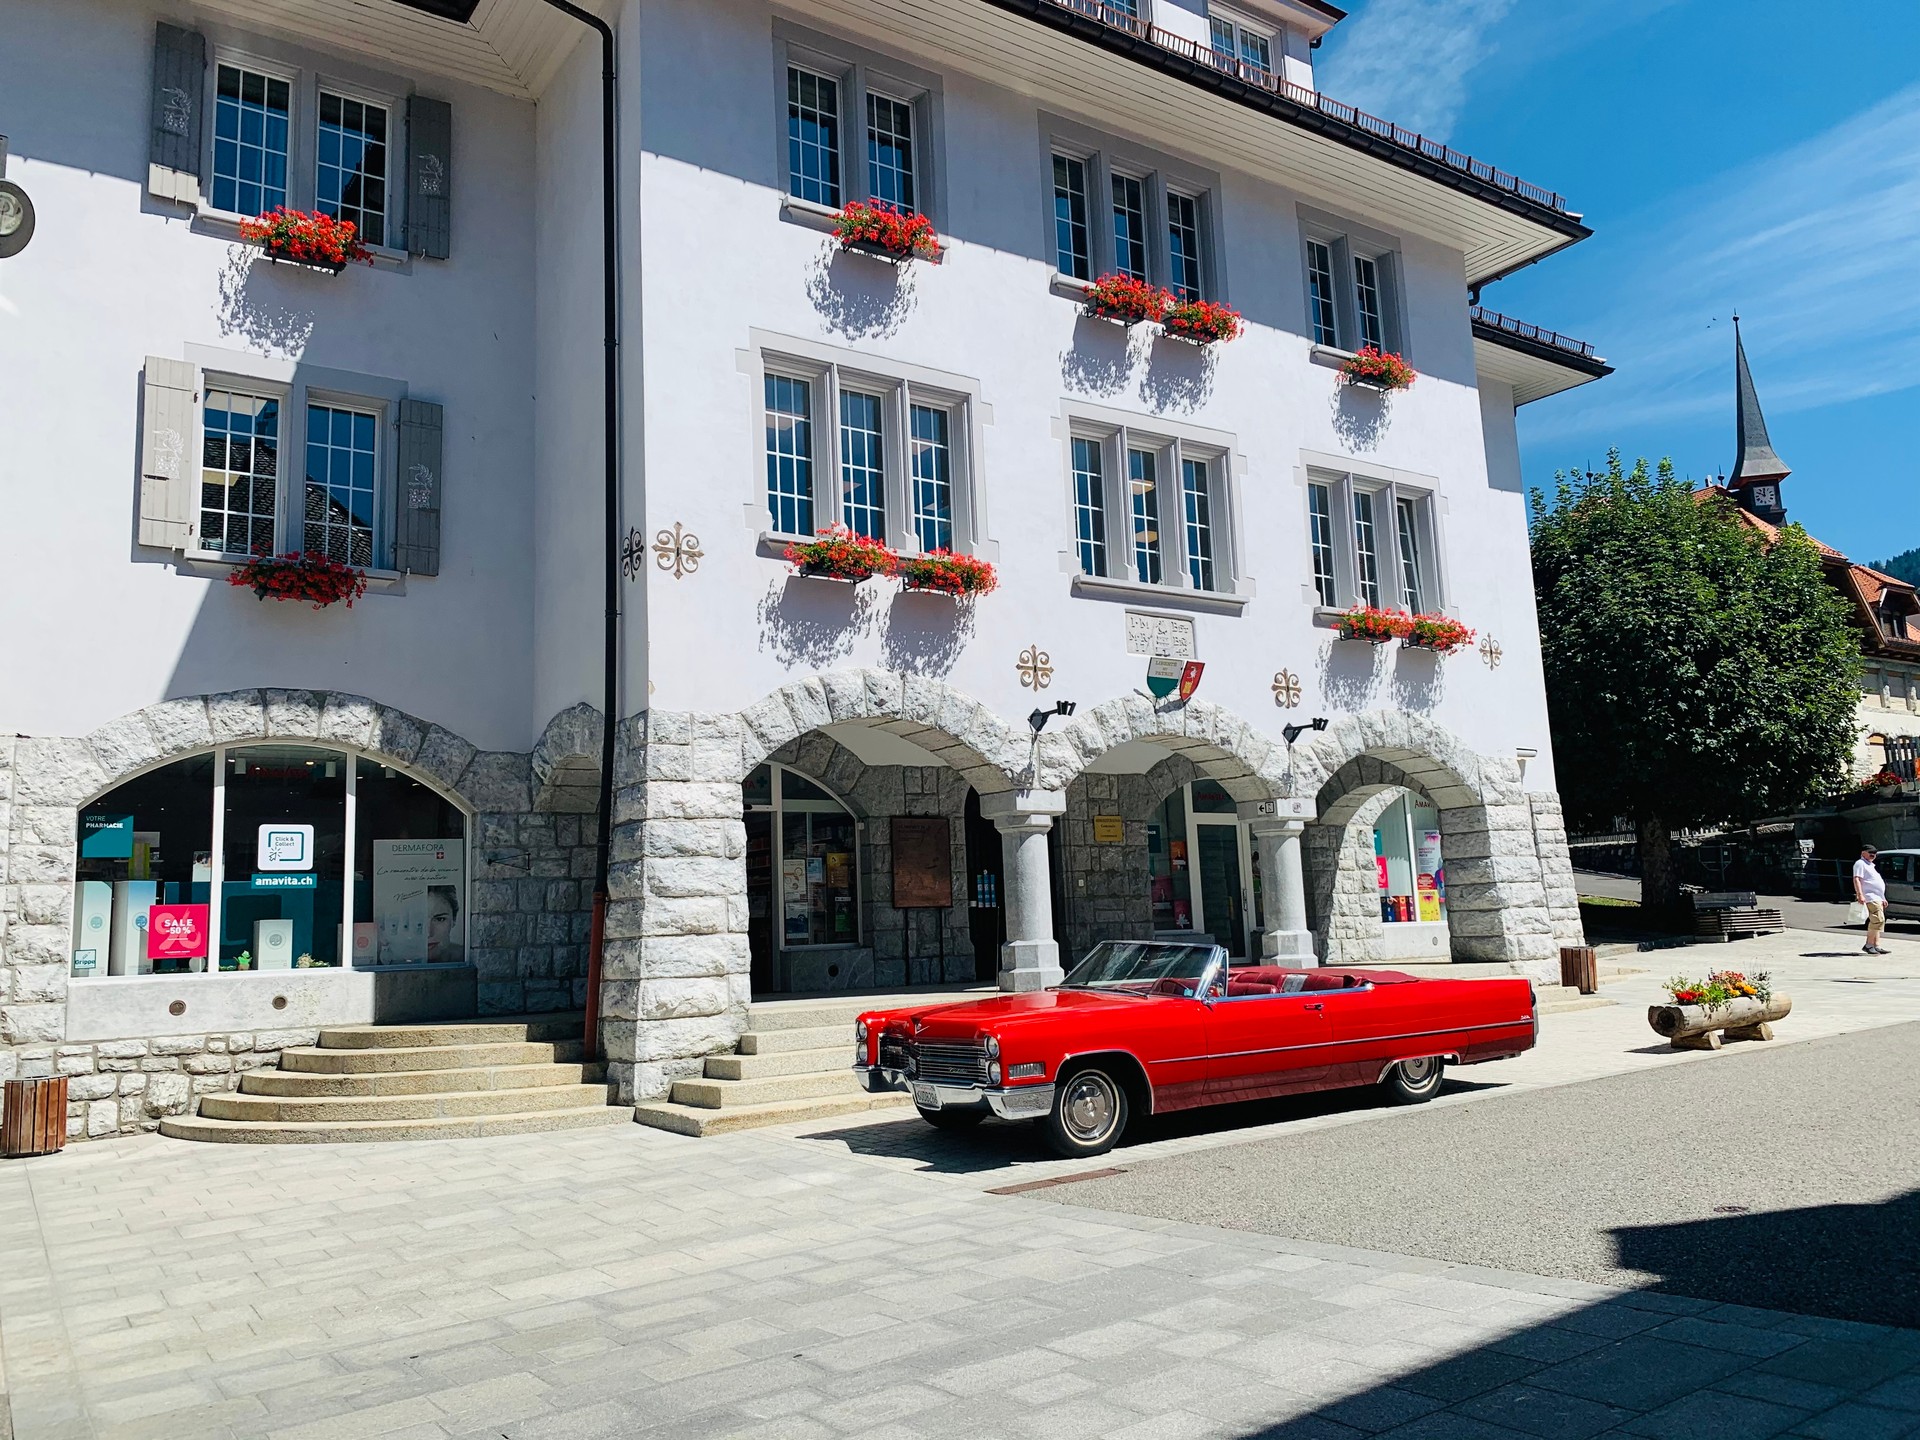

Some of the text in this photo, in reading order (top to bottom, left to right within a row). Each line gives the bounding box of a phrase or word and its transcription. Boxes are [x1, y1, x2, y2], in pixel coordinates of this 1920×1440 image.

[392, 843, 445, 852] DERMAFORA
[255, 875, 313, 886] amavita.ch
[164, 918, 194, 927] SALE
